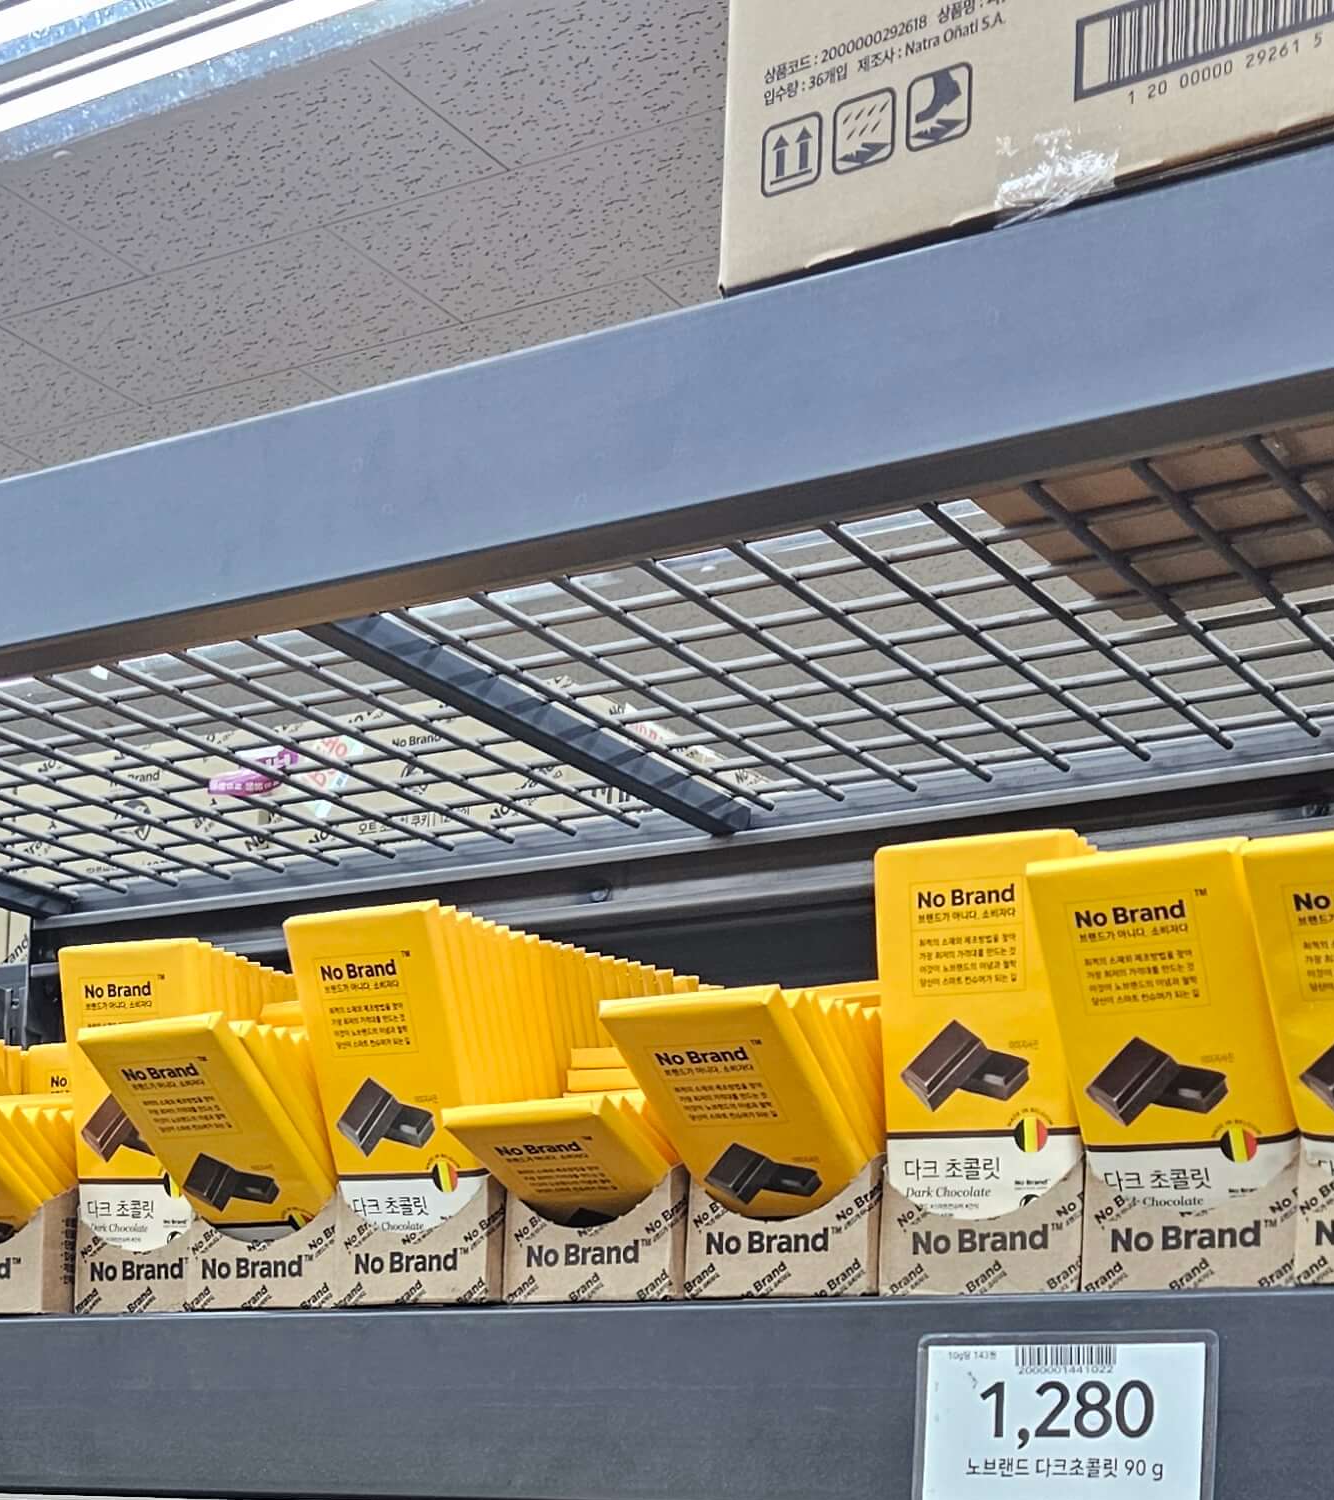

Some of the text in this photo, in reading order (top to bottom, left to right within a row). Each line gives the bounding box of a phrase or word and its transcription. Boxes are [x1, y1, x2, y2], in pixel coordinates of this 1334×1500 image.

[763, 55, 811, 84] 상품코드
[821, 15, 928, 64] 2000000292618
[764, 81, 798, 107] 입수량
[808, 64, 848, 91] 36개입
[857, 47, 896, 73] 제조사
[905, 33, 940, 58] Natra
[943, 17, 979, 44] Oñati
[1128, 32, 1323, 104] 1 20 00000 29261 5
[1075, 899, 1186, 928] No Brand
[904, 1157, 1001, 1181] 다크 초콜릿
[906, 1185, 991, 1198] Dark Chocolate
[706, 1228, 829, 1255] No Brand
[912, 1222, 1049, 1255] No Brand
[89, 1258, 184, 1282] No Brand
[980, 1380, 1154, 1450] 1,280
[966, 1458, 1030, 1479] 노브랜드
[1036, 1457, 1118, 1479] 다크초콜릿
[1125, 1459, 1146, 1476] 90
